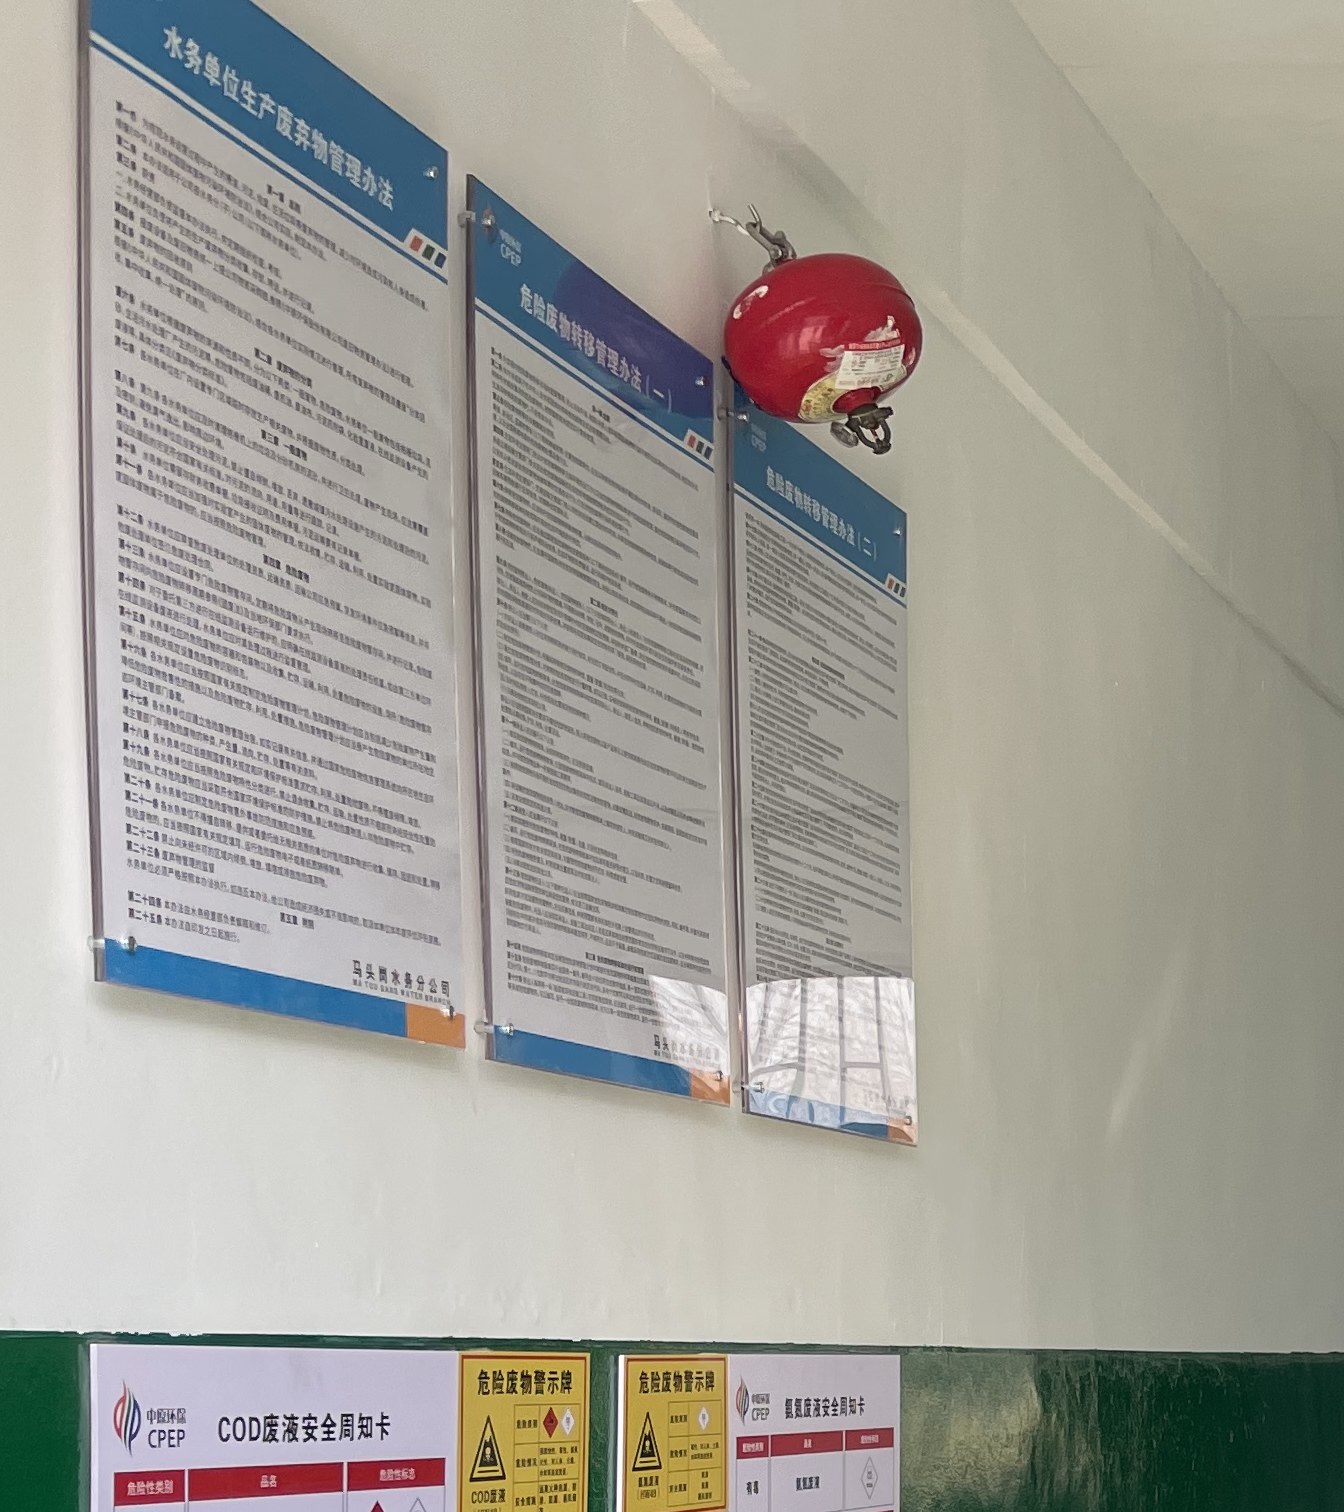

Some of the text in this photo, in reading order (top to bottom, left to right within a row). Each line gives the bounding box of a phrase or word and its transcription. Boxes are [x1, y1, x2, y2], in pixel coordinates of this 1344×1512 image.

[162, 26, 395, 212] 水务单位生产废弃物管理办法
[499, 240, 522, 272] CPEP
[519, 280, 673, 416] 危险废物转移管理办法（一）
[765, 462, 877, 565] 危险废物转移管理办法（二）
[476, 1368, 573, 1396] 危险废物警示牌
[638, 1369, 715, 1394] 危险废物警示牌
[751, 1406, 770, 1421] CPEP
[784, 1395, 865, 1420] 氨氮废液安全周知卡
[147, 1427, 186, 1450] CPEP
[217, 1410, 391, 1448] COD废液安全周知卡
[126, 1477, 174, 1498] 危险性类别
[259, 1473, 278, 1490] 品名
[470, 1487, 506, 1506] COD废液
